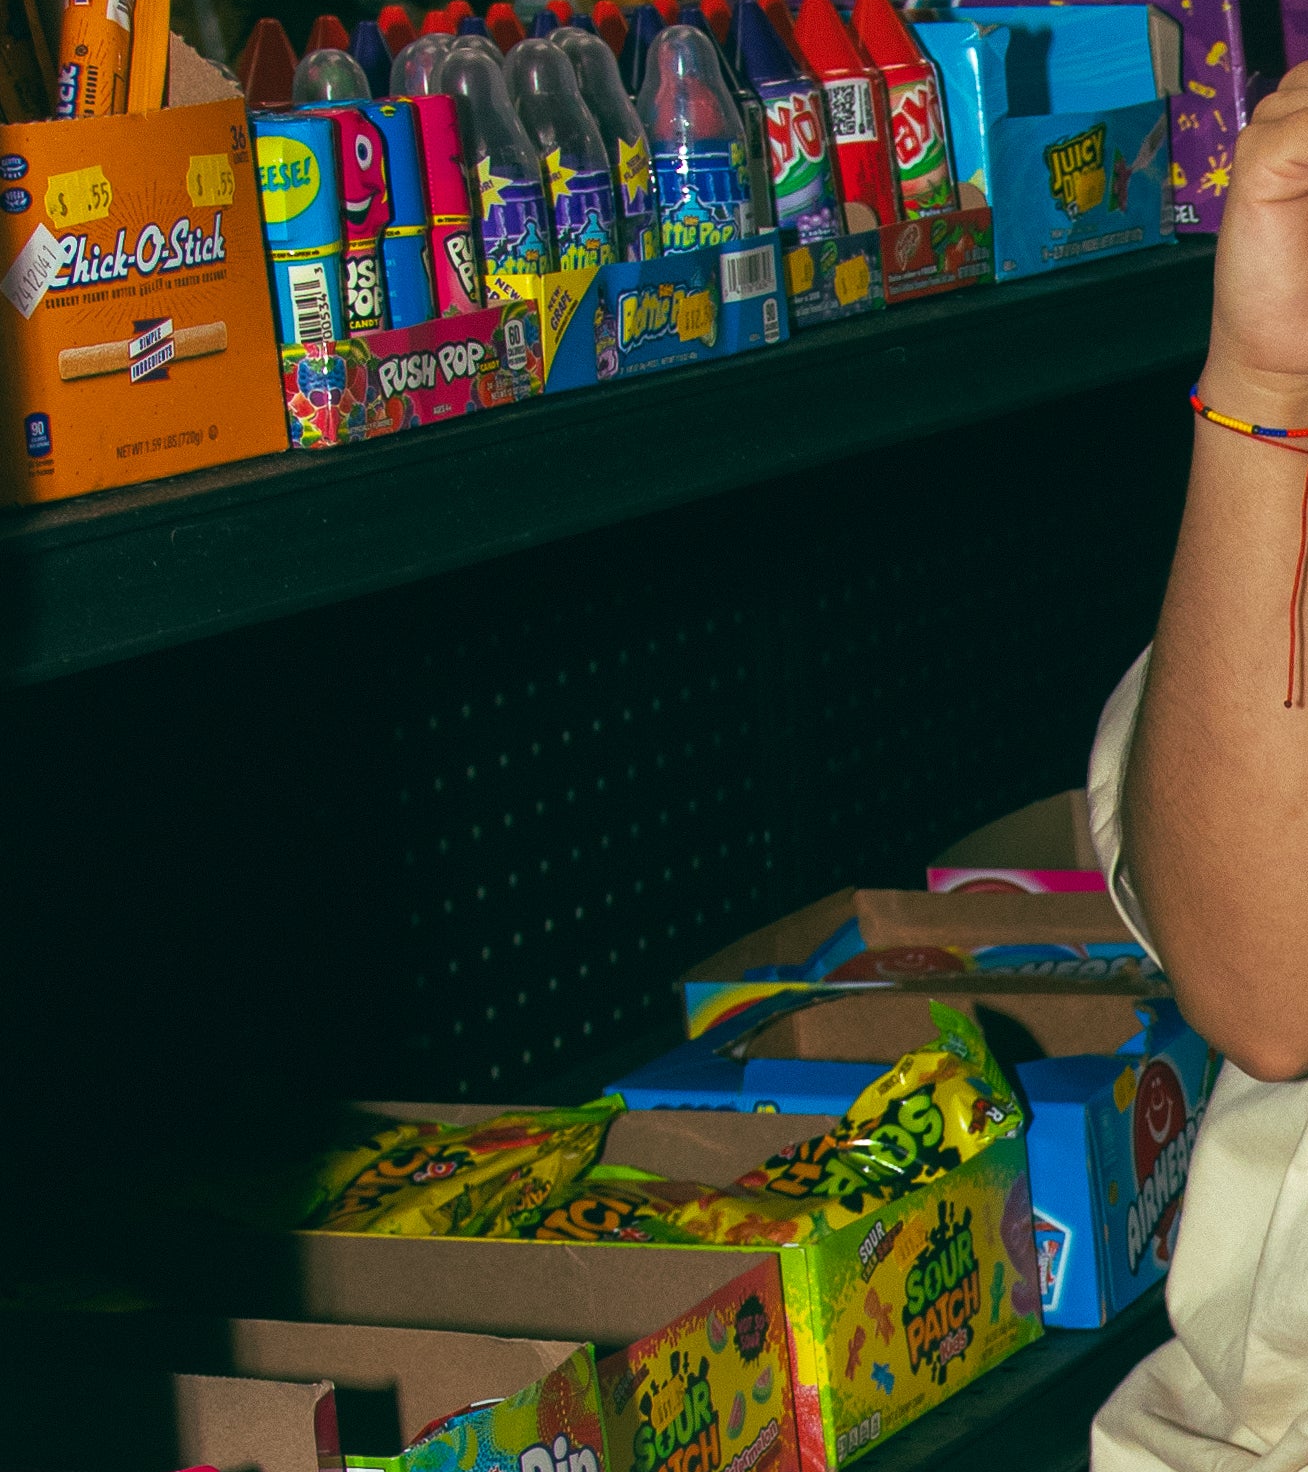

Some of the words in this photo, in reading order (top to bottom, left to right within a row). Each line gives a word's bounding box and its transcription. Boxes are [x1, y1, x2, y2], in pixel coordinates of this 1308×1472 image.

[230, 125, 247, 151] 36
[1051, 128, 1104, 195] JUICY
[87, 182, 110, 212] .55
[48, 211, 227, 291] Chick-O-Stick
[139, 327, 162, 351] SIMPLE
[508, 324, 521, 346] 60
[132, 344, 173, 380] INGREDIENTS
[379, 352, 436, 400] PUSH
[437, 338, 486, 383] POP
[30, 420, 45, 437] 90
[1126, 1116, 1206, 1276] AIRHEA
[859, 1220, 887, 1266] SOUR
[906, 1230, 974, 1316] SOUR
[905, 1270, 981, 1366] PATCH
